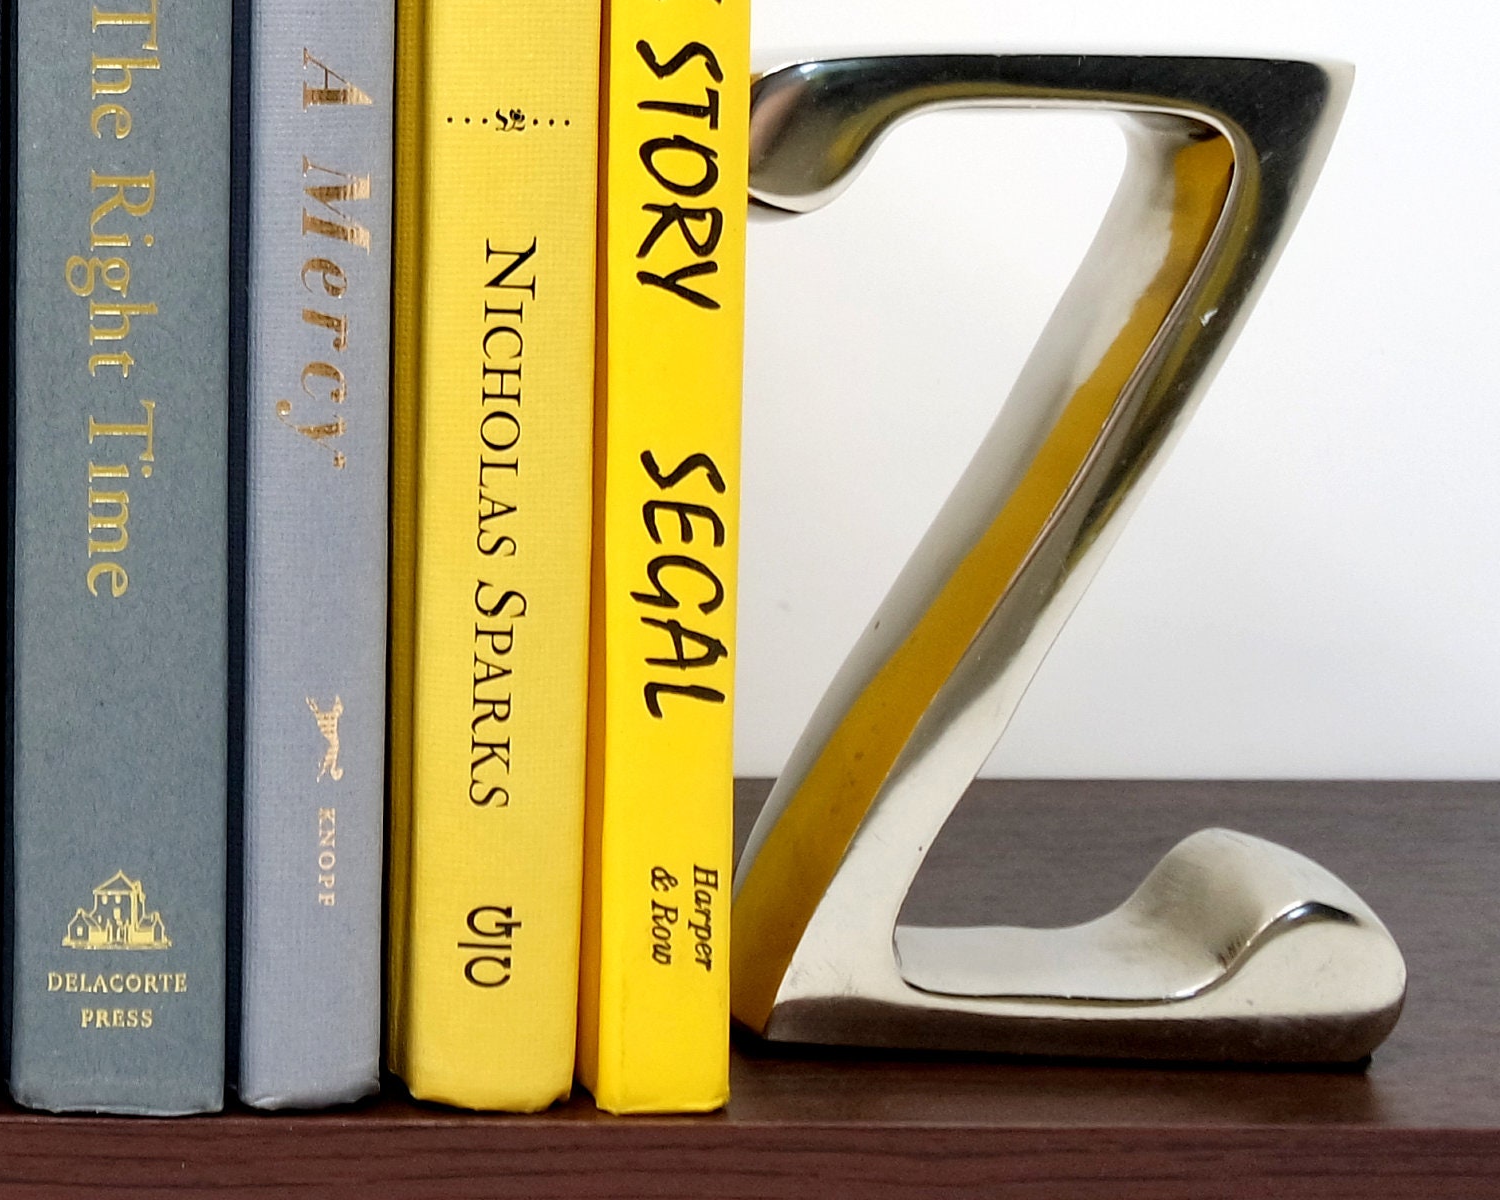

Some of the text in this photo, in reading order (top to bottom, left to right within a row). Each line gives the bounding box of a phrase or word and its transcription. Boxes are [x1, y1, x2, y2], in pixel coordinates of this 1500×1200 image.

[65, 170, 159, 378] Right
[276, 47, 373, 469] A Mercy
[634, 40, 724, 312] STORY
[87, 400, 156, 598] Time
[468, 236, 537, 809] NICHOLAS SPARKS
[630, 450, 728, 719] SEGAL
[317, 807, 336, 907] KNOPF
[650, 866, 678, 966] & Row
[693, 863, 719, 972] Harper
[47, 972, 188, 993] DELACORTE
[80, 1008, 154, 1028] PRESS
